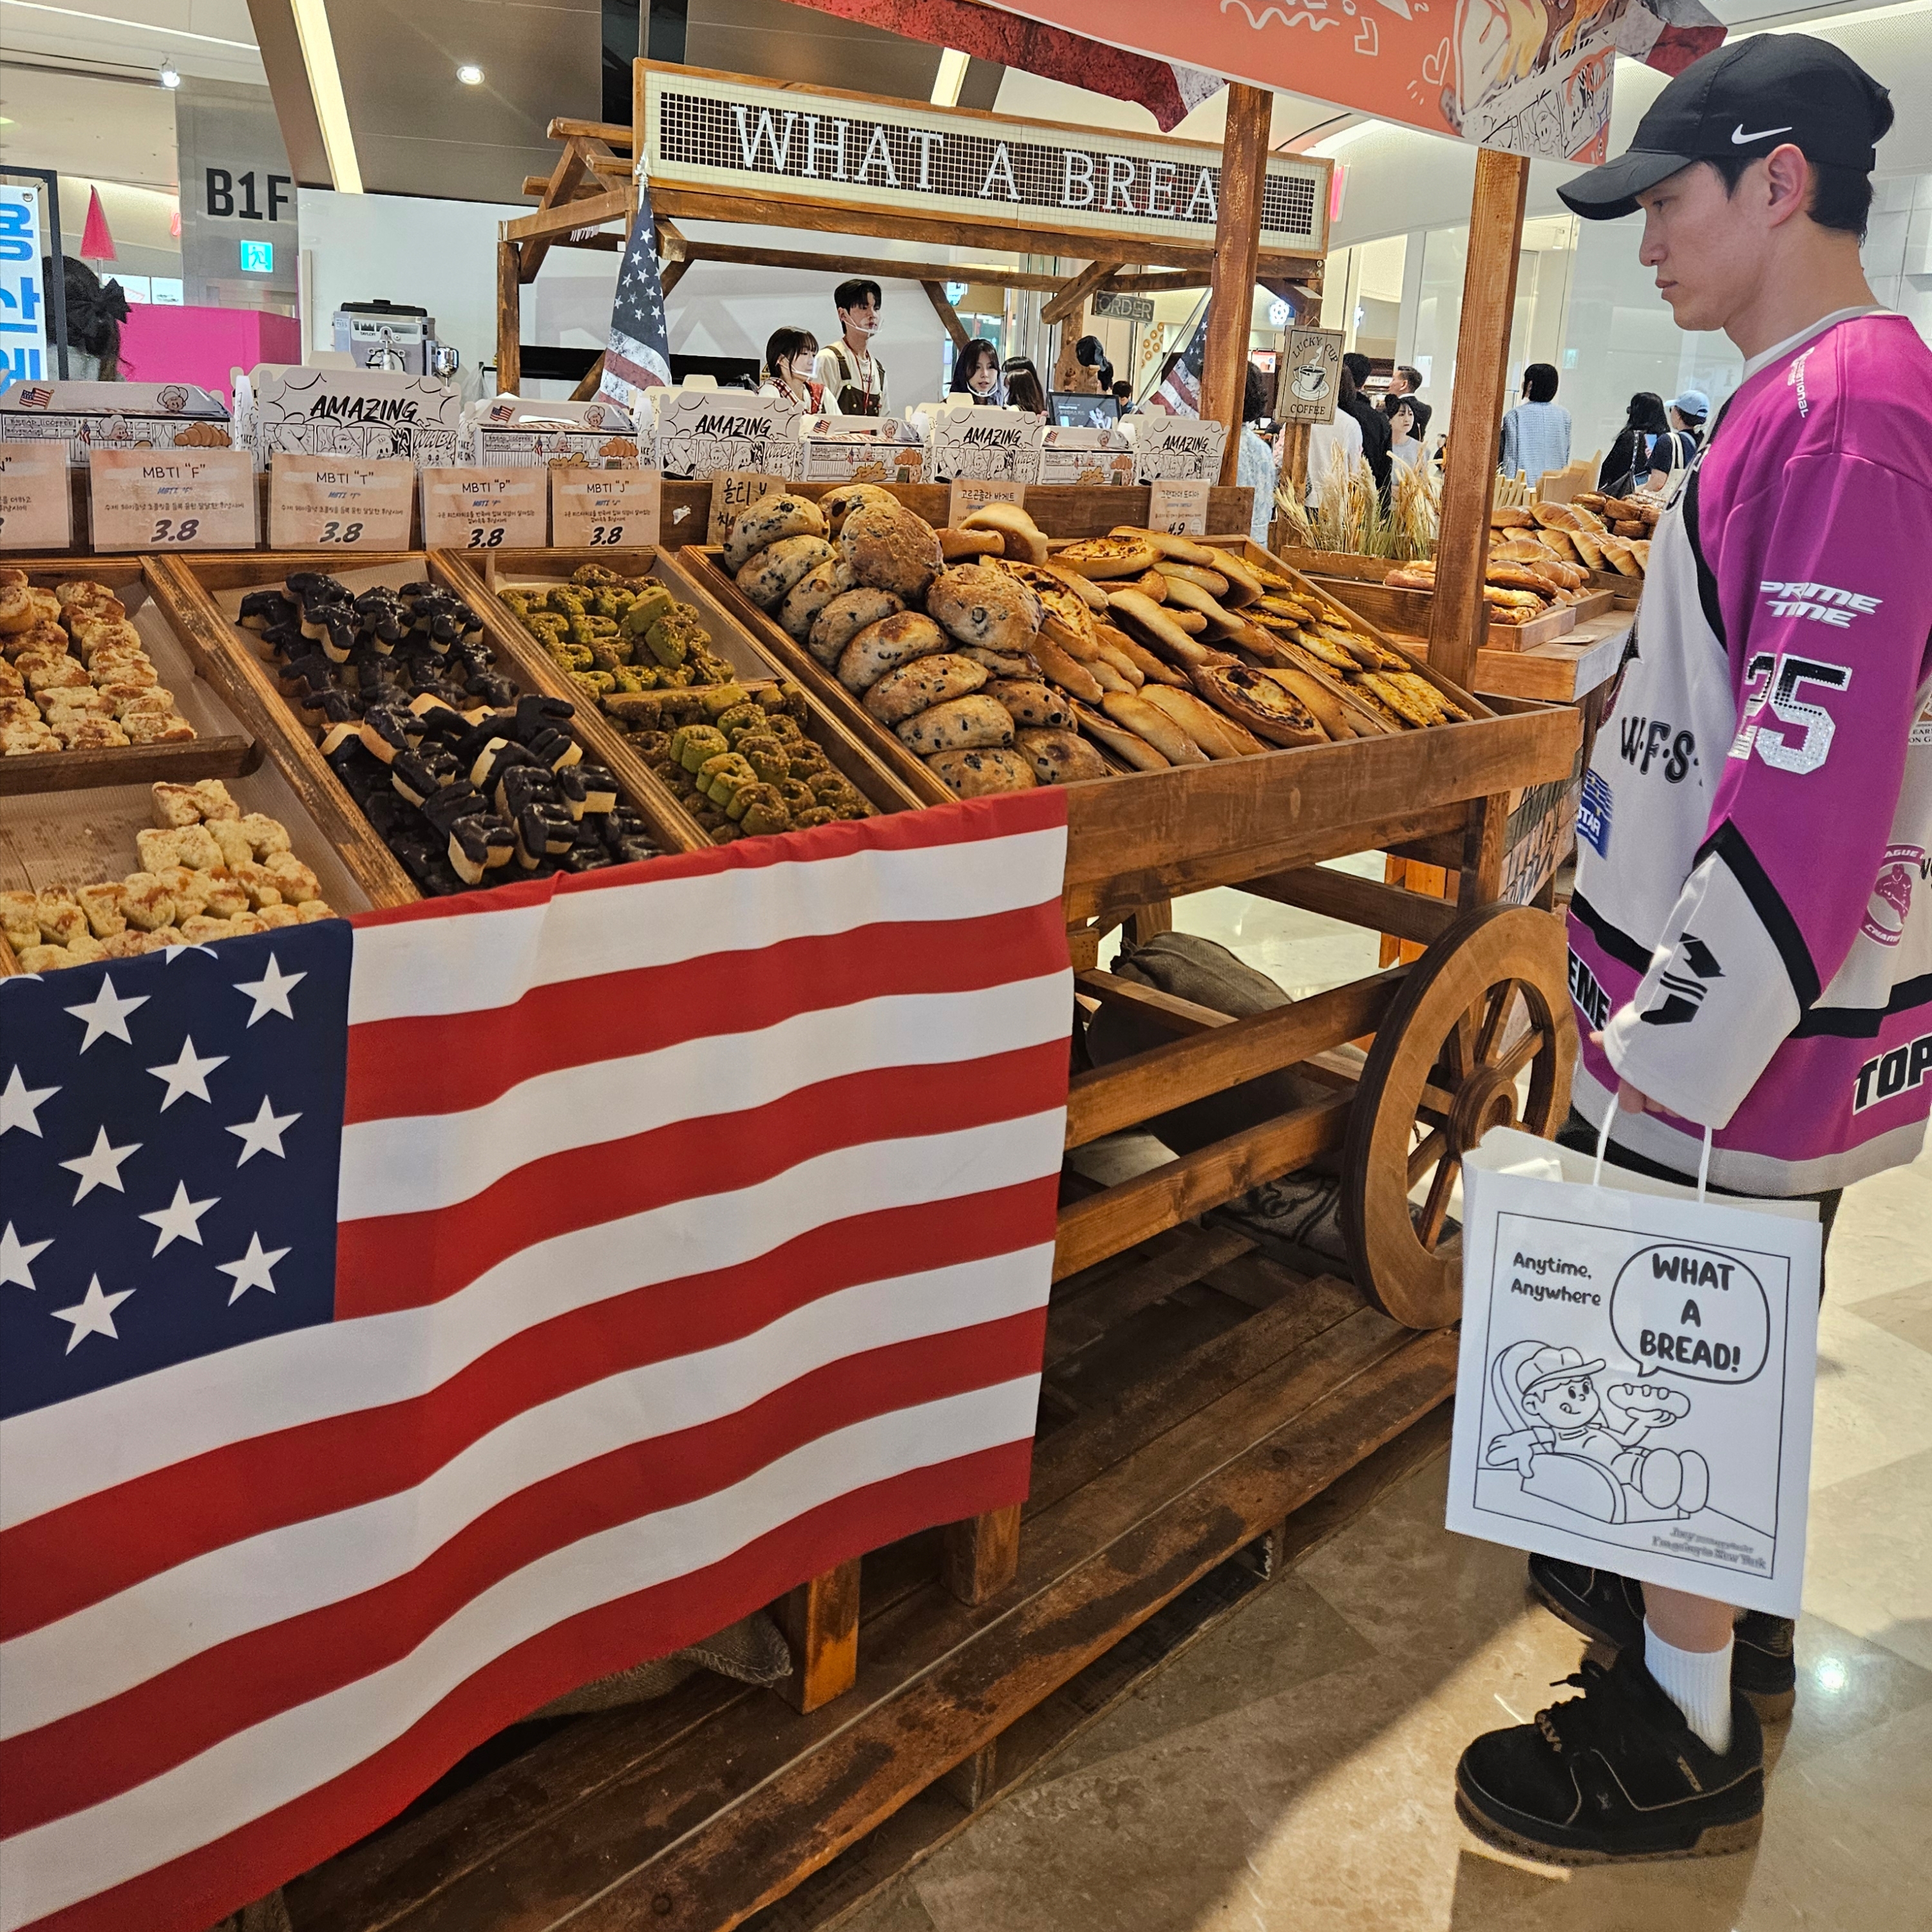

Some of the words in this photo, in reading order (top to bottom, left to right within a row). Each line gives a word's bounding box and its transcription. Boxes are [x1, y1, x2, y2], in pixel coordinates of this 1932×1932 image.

[731, 106, 943, 191] WHAT
[978, 143, 1021, 201] A
[1061, 151, 1218, 223] BREA
[206, 168, 292, 221] B1F
[1099, 296, 1151, 319] ORDER
[1293, 337, 1323, 358] LUCKY
[1325, 344, 1338, 362] CUP
[310, 395, 419, 421] AMAZING
[1291, 404, 1325, 415] COFFEE
[694, 415, 772, 437] AMAZING
[963, 427, 1022, 444] AMAZING
[1162, 435, 1209, 451] AMAZING
[143, 467, 180, 478] MBTI
[316, 471, 348, 484] MBTI
[462, 482, 490, 493] MBTI
[587, 483, 612, 493] MBTI
[994, 492, 1014, 502] 바게트
[151, 519, 200, 542] 3.8
[319, 522, 363, 543] 3.8
[468, 528, 504, 547] 3.8
[590, 526, 623, 546] 3.8
[1168, 522, 1185, 535] 4.9
[1884, 849, 1918, 858] AGUE
[1513, 1251, 1592, 1280] Anytime,
[1652, 1253, 1735, 1291] WHAT
[1510, 1277, 1601, 1307] Anywhere
[1681, 1298, 1701, 1328] A
[1640, 1329, 1741, 1374] BREAD!
